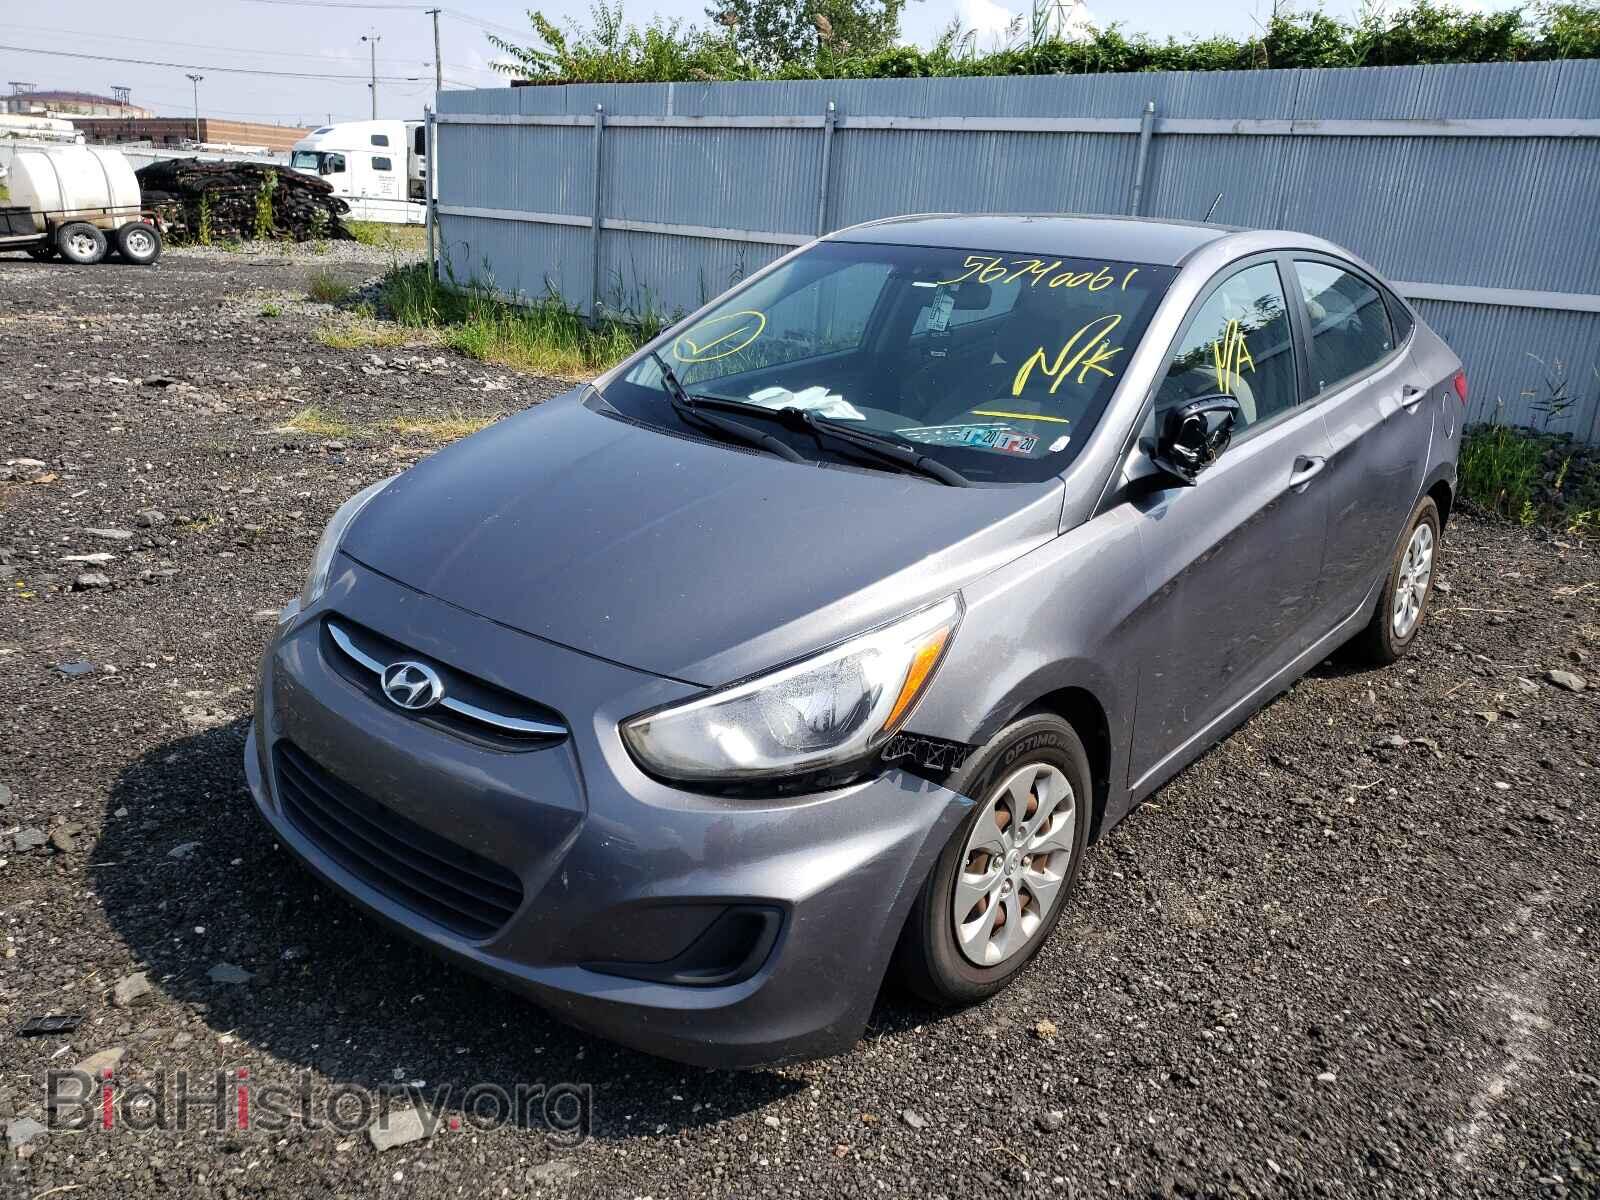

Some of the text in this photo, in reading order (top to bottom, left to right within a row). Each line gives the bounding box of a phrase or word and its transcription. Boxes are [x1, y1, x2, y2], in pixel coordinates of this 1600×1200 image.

[935, 255, 1139, 291] 56740061
[983, 431, 996, 443] 20
[1020, 438, 1034, 450] 20
[1006, 734, 1057, 764] OPTIMO
